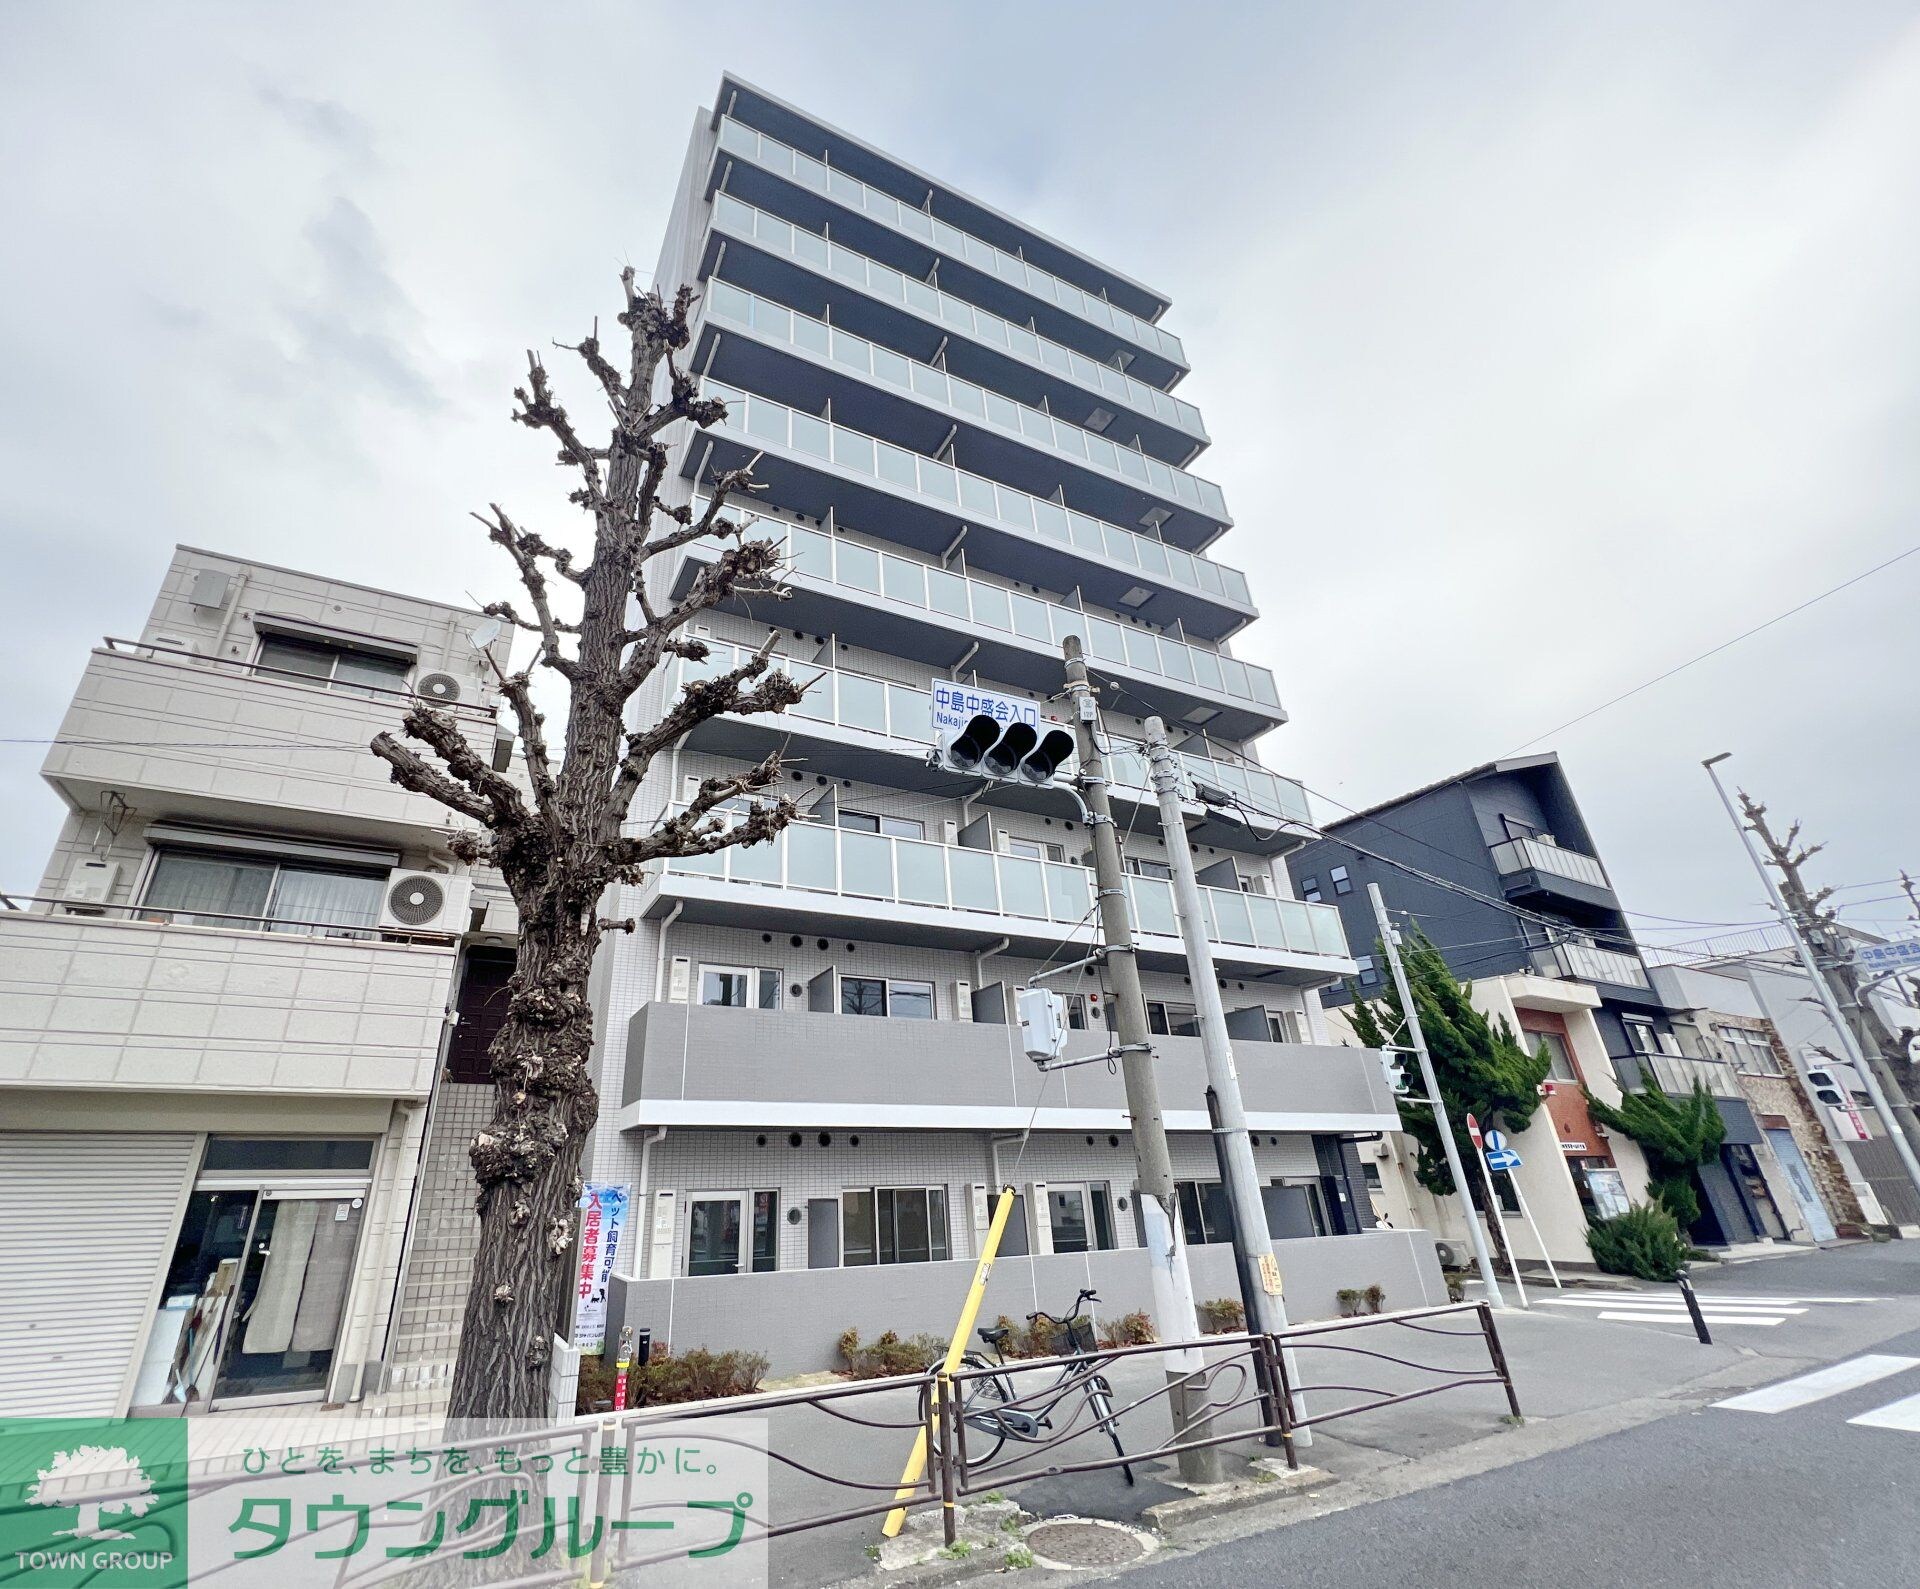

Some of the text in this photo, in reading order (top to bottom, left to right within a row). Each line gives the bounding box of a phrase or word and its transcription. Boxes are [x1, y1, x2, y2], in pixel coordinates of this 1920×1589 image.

[936, 687, 1036, 727] 中島中盛会入口
[579, 1192, 603, 1300] 入居者募集中
